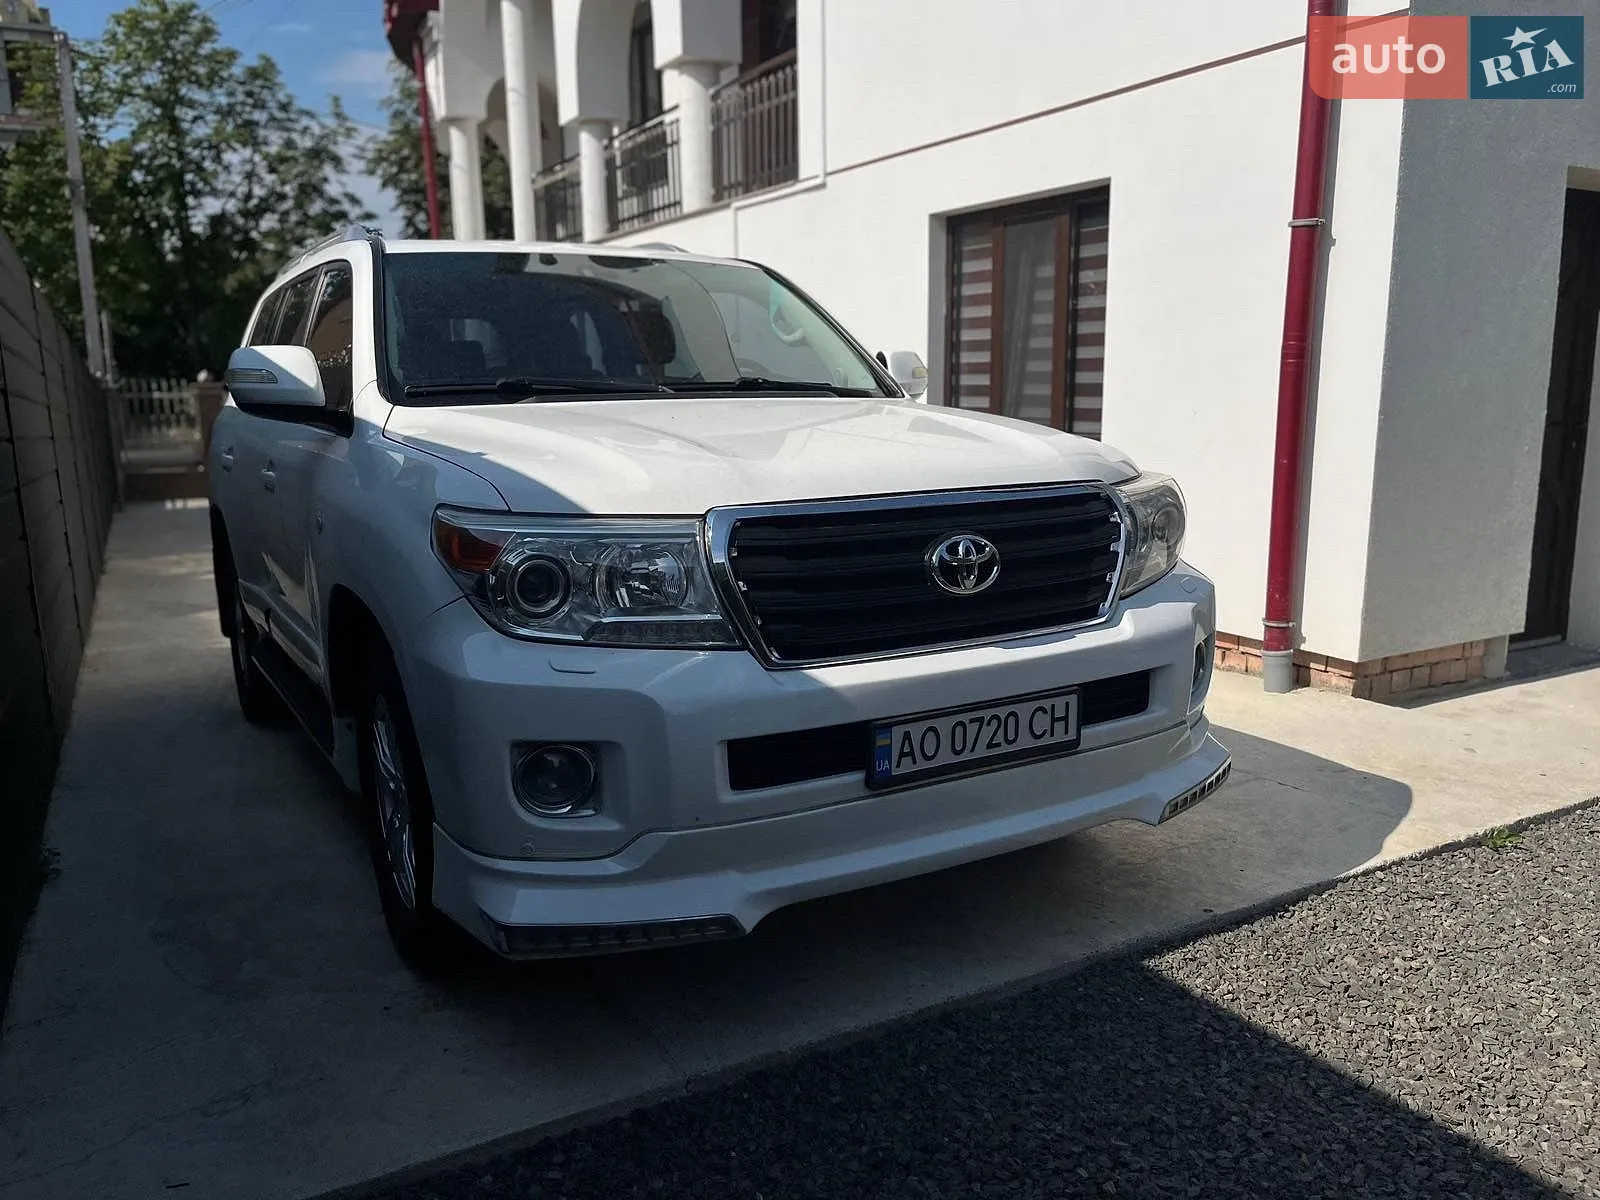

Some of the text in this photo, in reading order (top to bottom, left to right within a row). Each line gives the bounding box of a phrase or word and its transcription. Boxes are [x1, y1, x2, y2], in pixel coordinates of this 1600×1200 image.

[896, 701, 1070, 769] AO 0720 CH
[876, 761, 890, 772] UA
